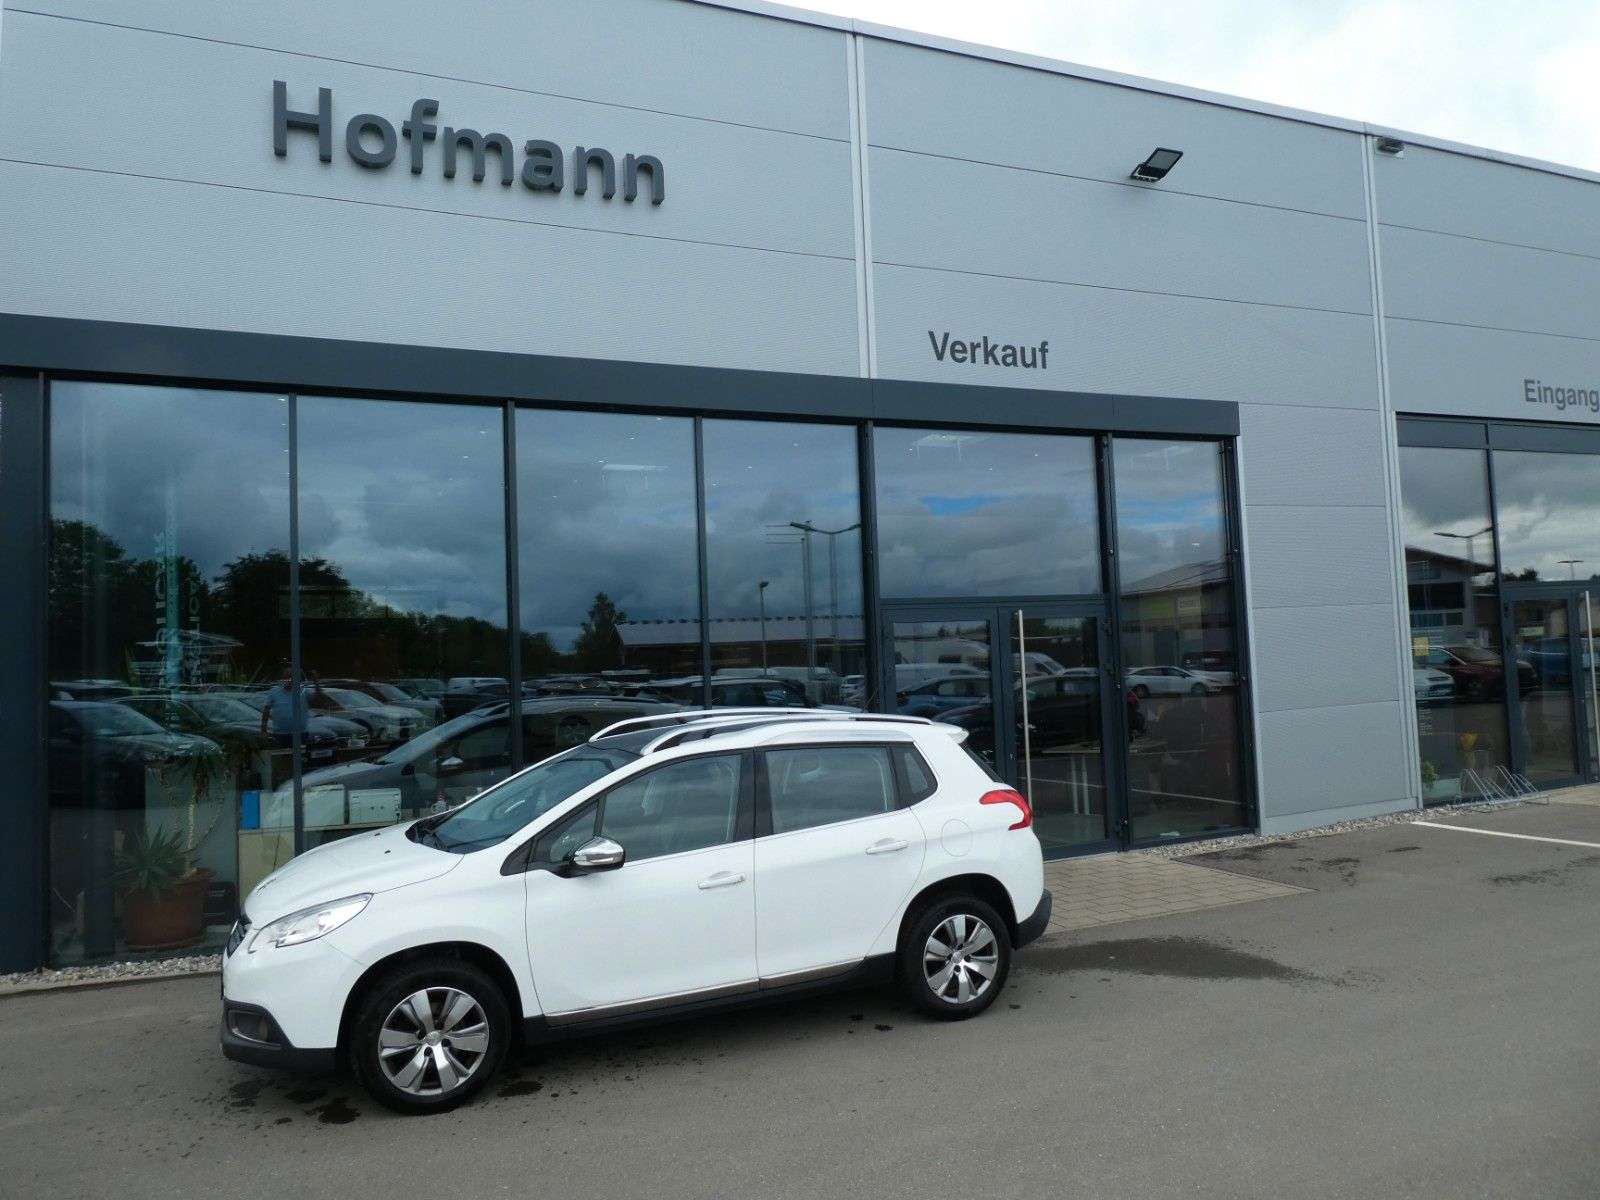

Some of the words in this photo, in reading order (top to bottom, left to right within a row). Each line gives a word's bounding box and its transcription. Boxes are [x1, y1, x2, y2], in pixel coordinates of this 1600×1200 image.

[272, 80, 666, 206] Hofmann
[928, 331, 1049, 370] Verkauf
[1524, 379, 1600, 413] Eingang
